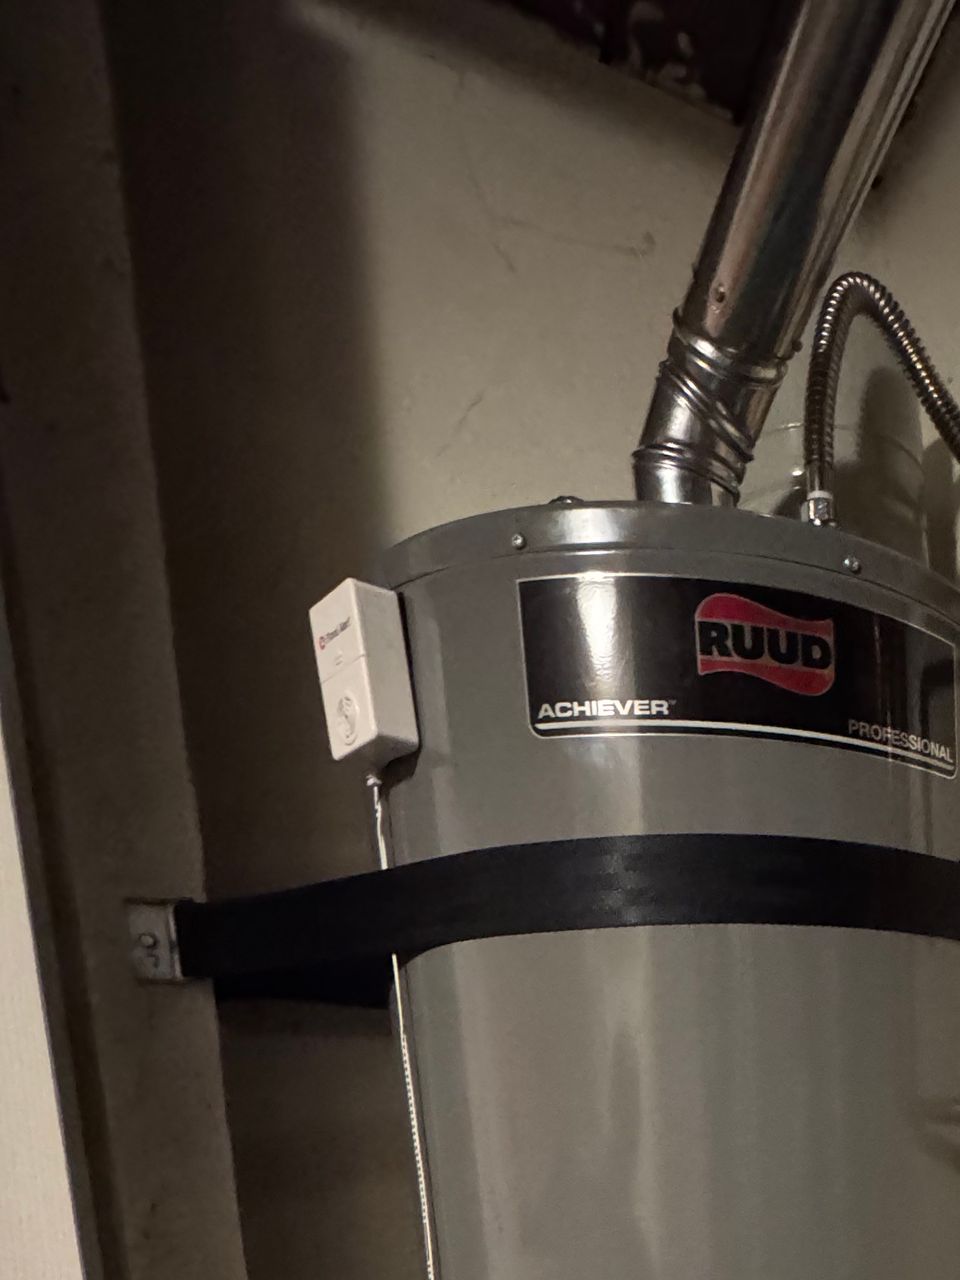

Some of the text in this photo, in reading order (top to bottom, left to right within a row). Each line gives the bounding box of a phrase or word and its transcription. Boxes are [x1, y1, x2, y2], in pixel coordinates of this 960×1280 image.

[699, 620, 833, 670] RUUD
[537, 699, 670, 719] ACHIEVER
[847, 719, 954, 764] PROFESSIONAL
